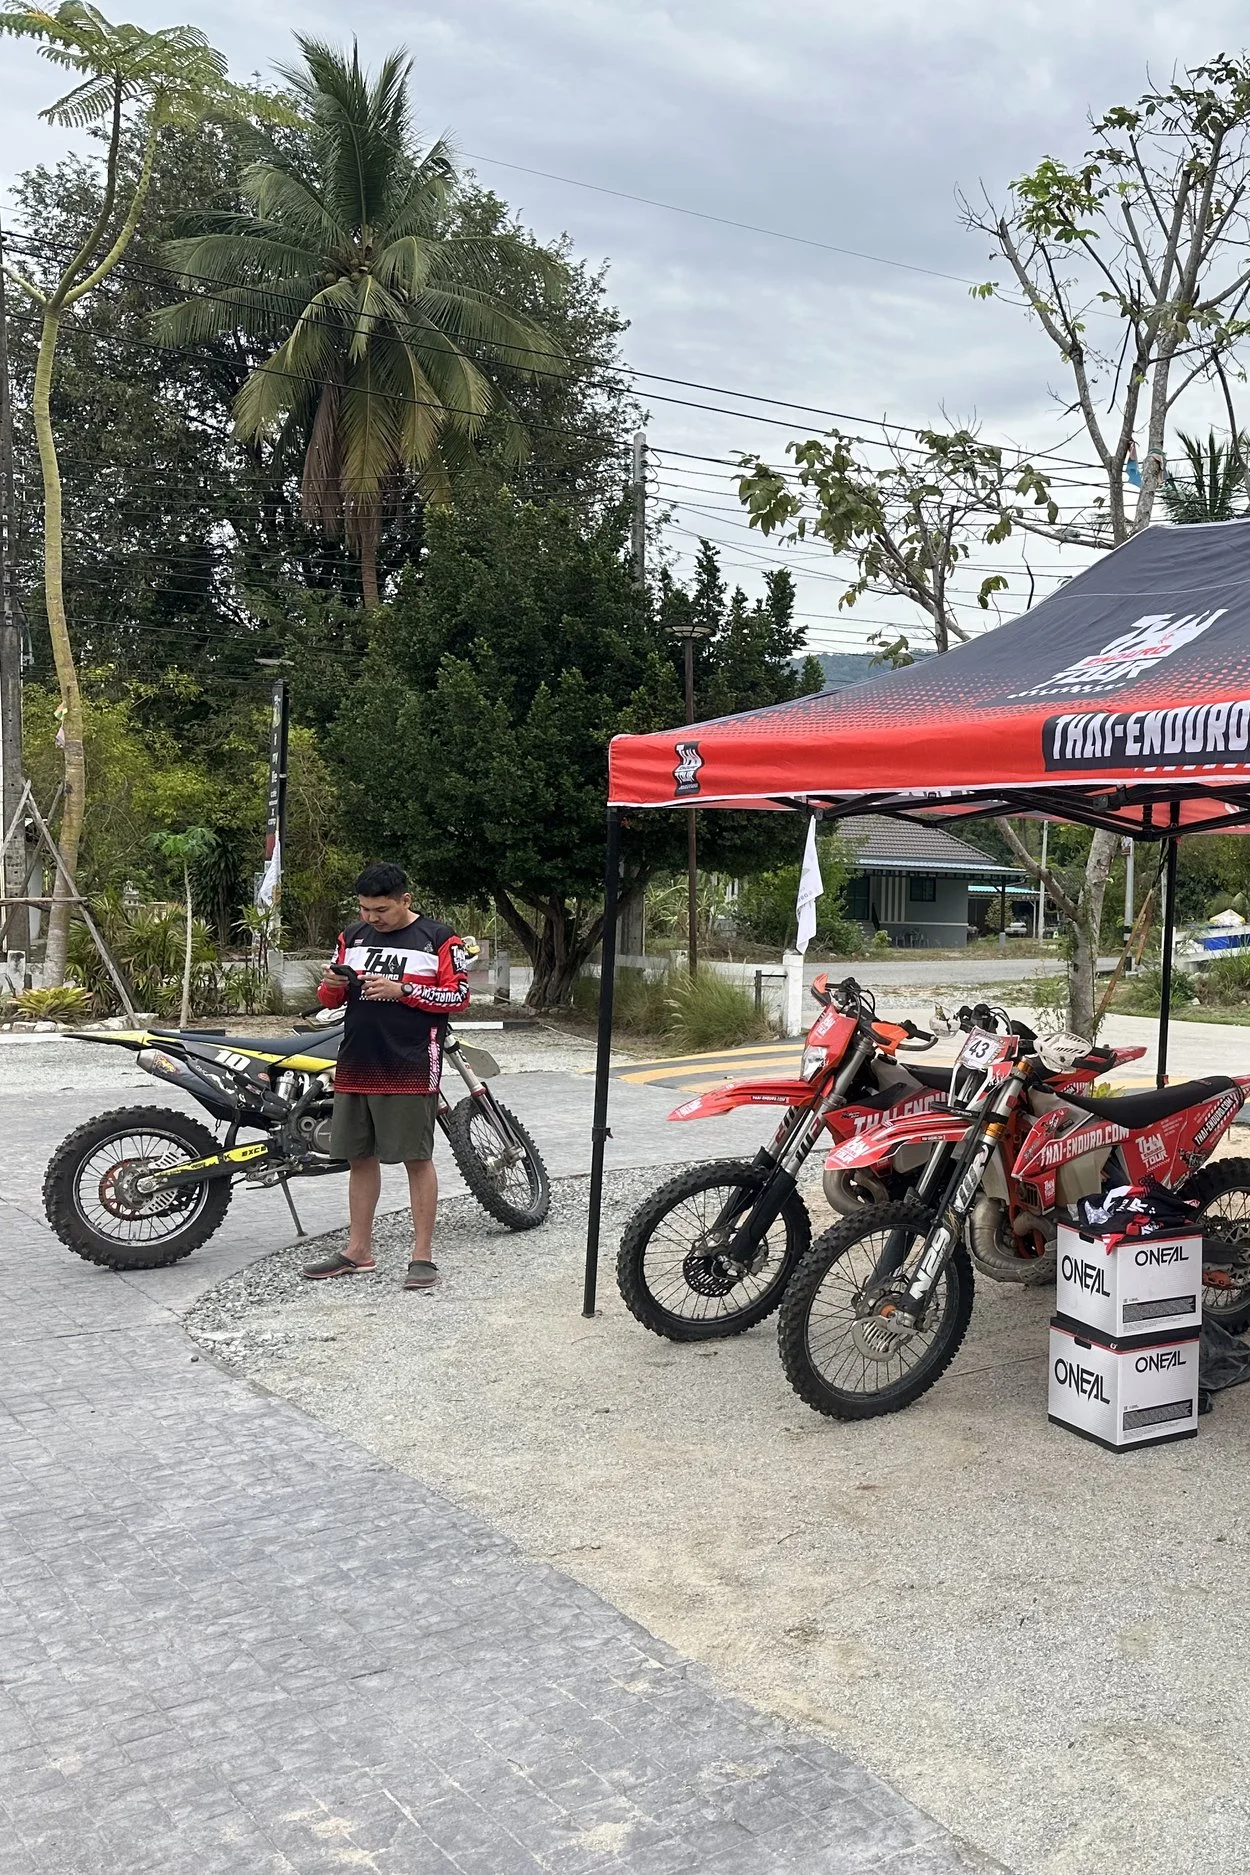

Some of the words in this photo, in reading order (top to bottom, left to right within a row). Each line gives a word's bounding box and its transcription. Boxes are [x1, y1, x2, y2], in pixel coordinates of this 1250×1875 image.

[1081, 645, 1171, 666] ENDURO
[1032, 658, 1163, 690] TOUR
[214, 1049, 251, 1072] 10
[969, 1039, 991, 1059] 43
[1194, 1097, 1235, 1146] THAI-ENDURO.COM
[1039, 1123, 1130, 1168] THAI-ENDURO.COM
[1144, 1151, 1169, 1168] TOUR
[1135, 1246, 1189, 1268] O'NEAL
[1062, 1254, 1111, 1298] O'NEAL
[1135, 1350, 1187, 1373] O'NEAL
[1054, 1358, 1111, 1405] O'NEAL
